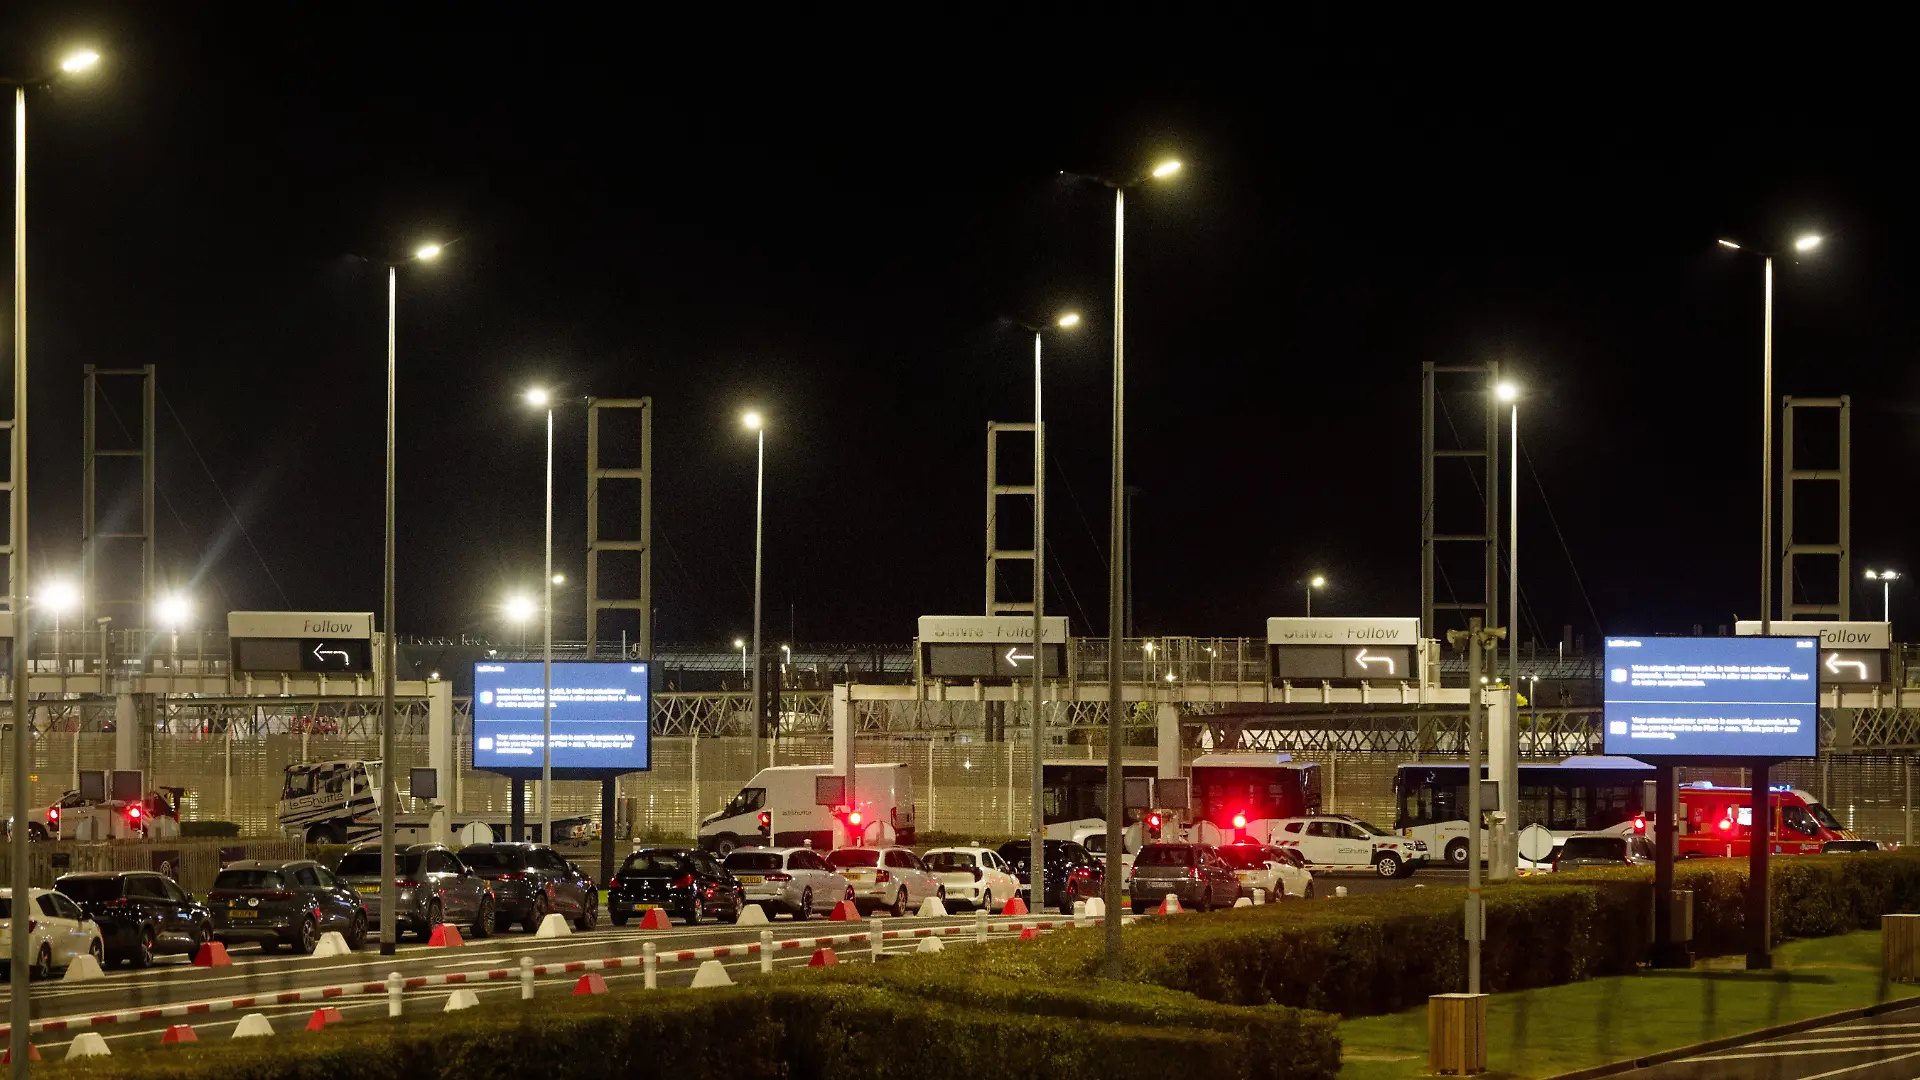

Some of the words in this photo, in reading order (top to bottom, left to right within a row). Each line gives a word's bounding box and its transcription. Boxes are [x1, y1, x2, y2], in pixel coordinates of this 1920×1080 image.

[303, 620, 353, 633] Follow
[1347, 627, 1400, 639] Follow
[1819, 629, 1872, 643] Follow
